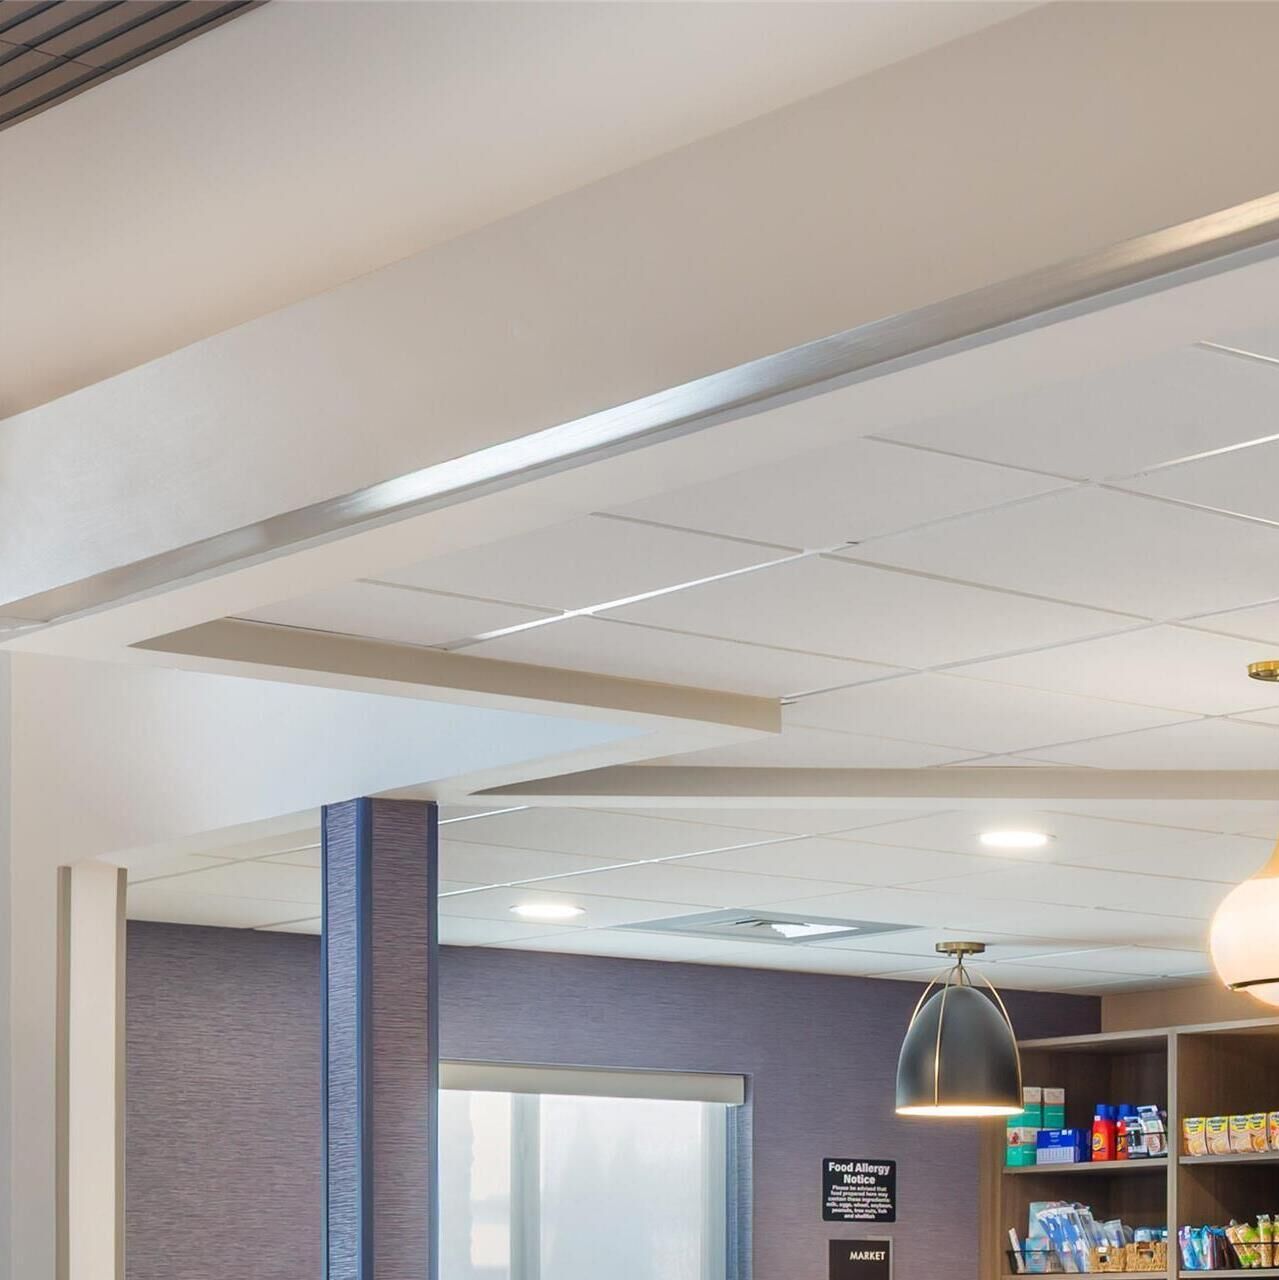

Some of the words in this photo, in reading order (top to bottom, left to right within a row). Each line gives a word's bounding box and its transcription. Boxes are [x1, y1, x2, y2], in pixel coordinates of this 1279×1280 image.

[829, 1162, 853, 1172] Food
[855, 1163, 890, 1175] Allergy
[844, 1174, 875, 1184] Notice
[850, 1251, 885, 1260] MARKET
